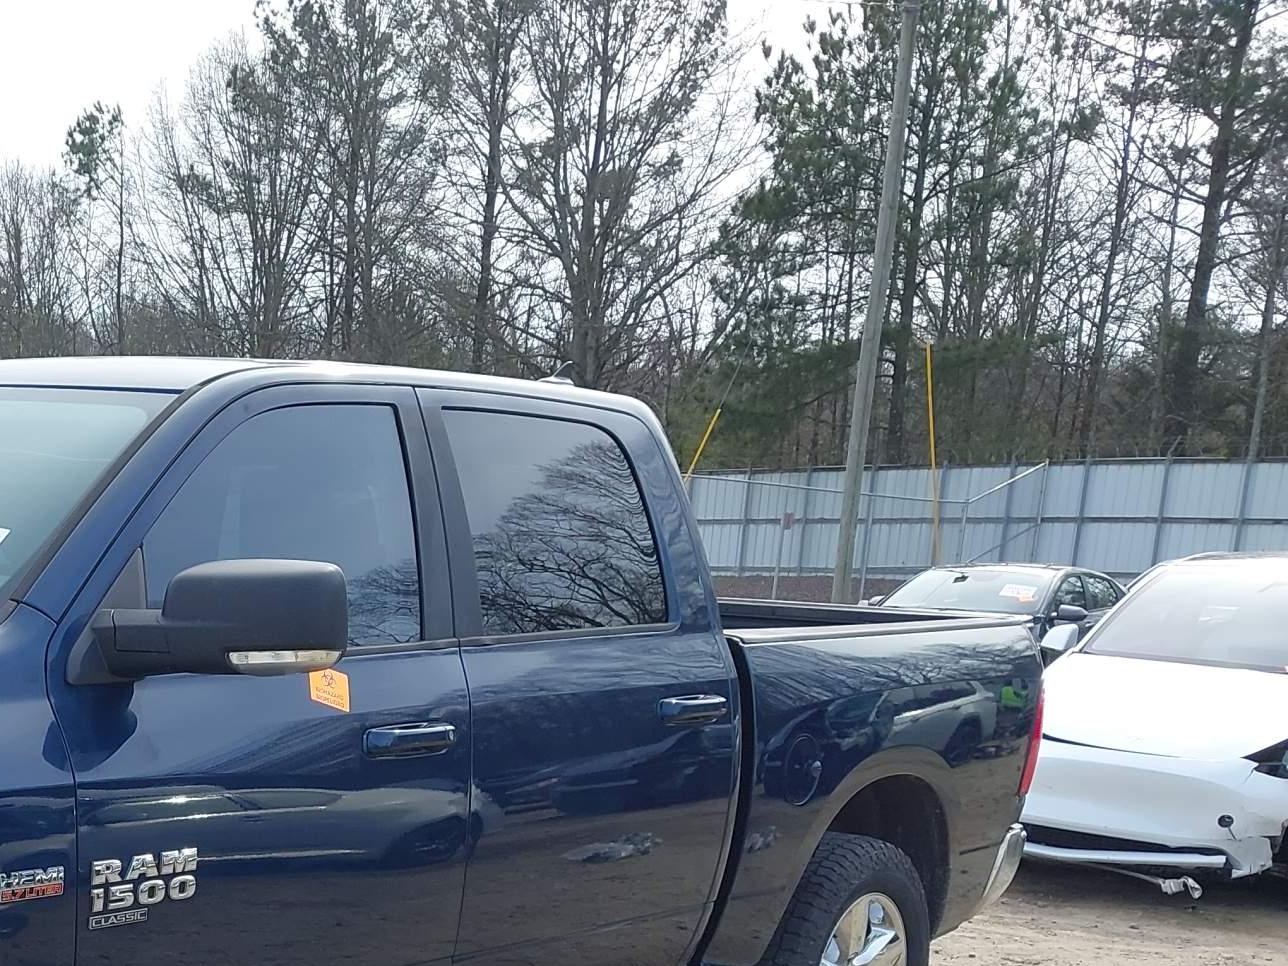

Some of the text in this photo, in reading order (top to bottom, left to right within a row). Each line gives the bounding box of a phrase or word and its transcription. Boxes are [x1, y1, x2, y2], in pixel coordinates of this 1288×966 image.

[91, 848, 198, 885] RAM
[90, 875, 197, 913] 1500
[92, 909, 146, 928] CLASSIC
